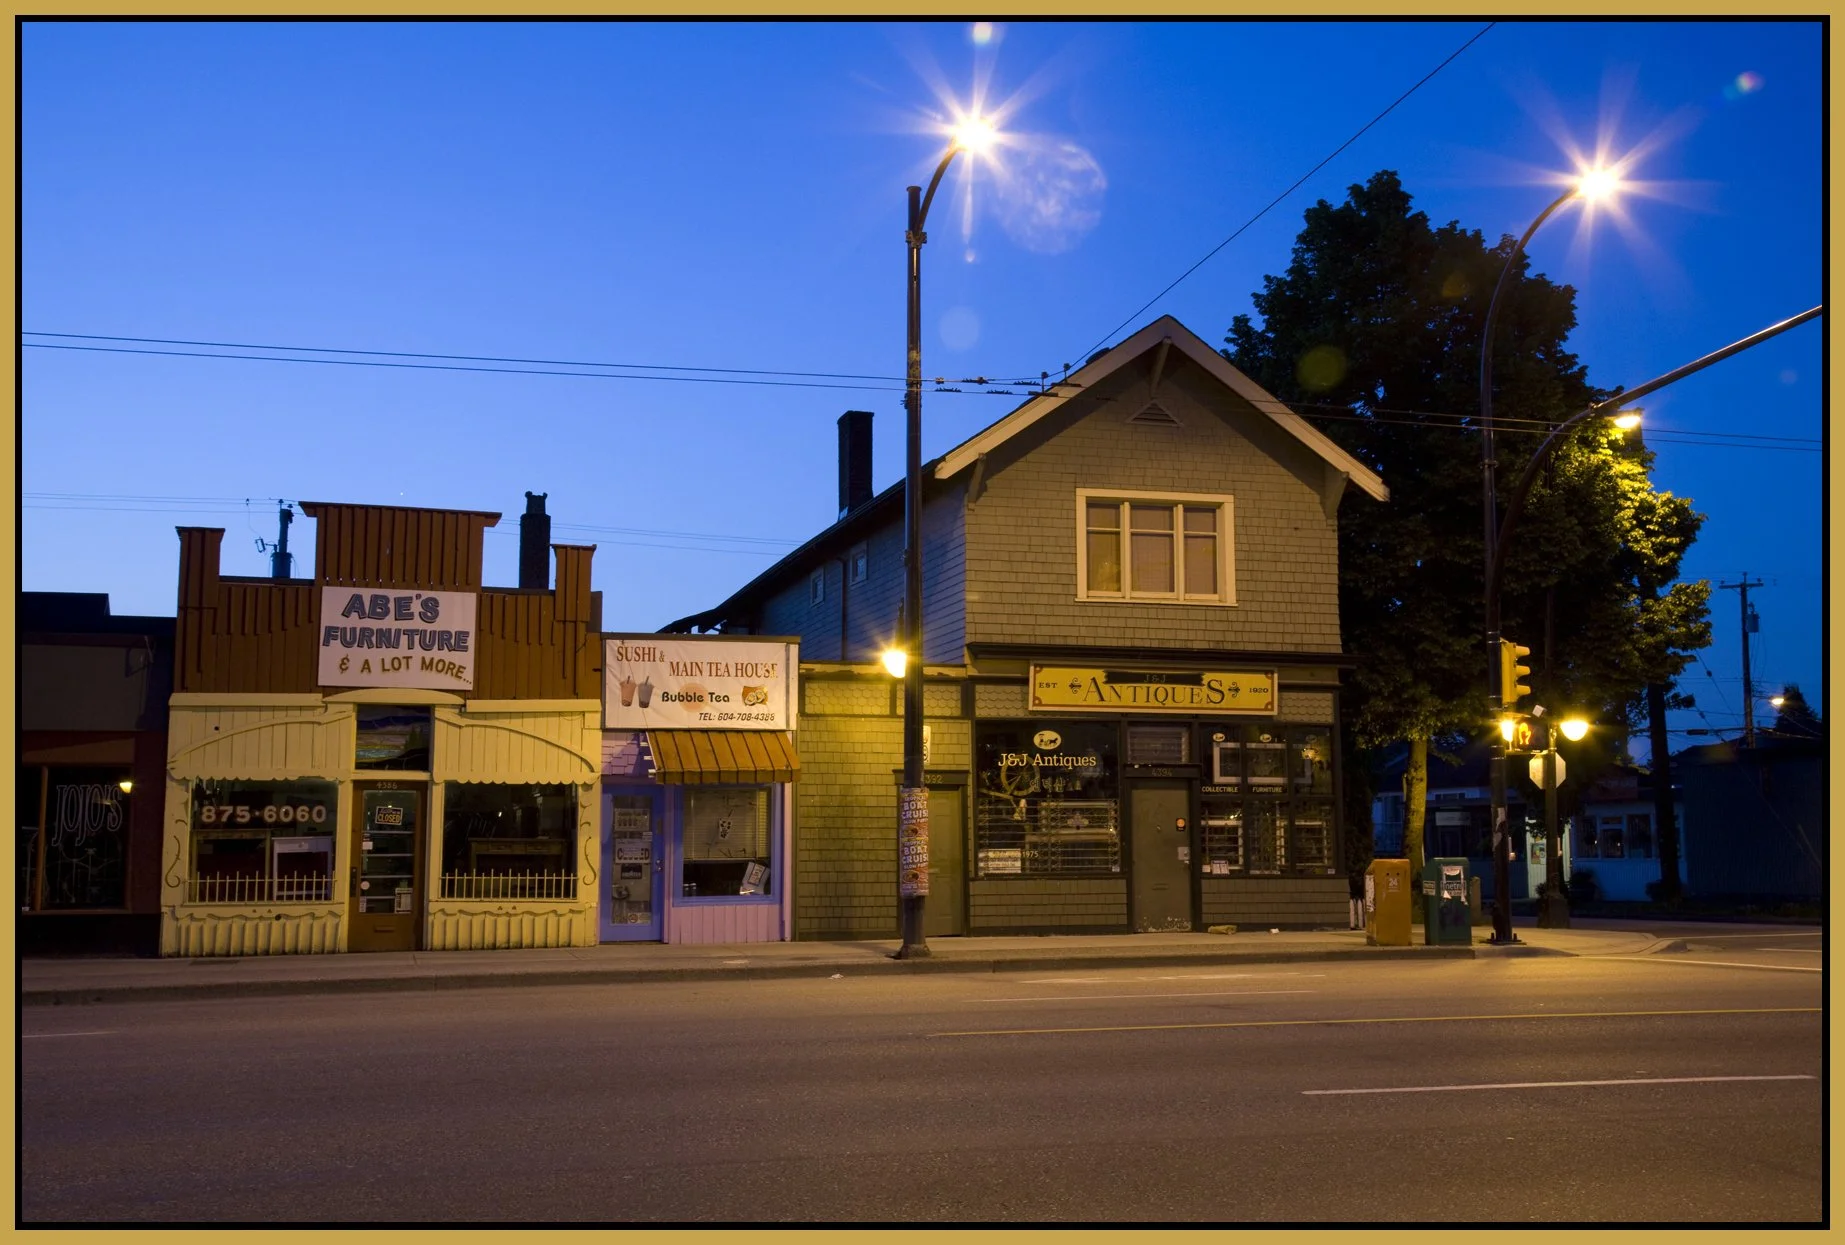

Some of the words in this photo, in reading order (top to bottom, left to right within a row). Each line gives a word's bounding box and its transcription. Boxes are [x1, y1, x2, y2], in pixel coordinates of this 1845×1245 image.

[341, 593, 440, 623] ABE'S
[322, 625, 470, 652] FURNITURE
[616, 646, 656, 663] SUSHI
[658, 650, 665, 663] &
[360, 659, 372, 673] A
[381, 656, 413, 672] LOT
[669, 661, 704, 677] MAIN
[707, 662, 731, 678] TEA
[734, 662, 778, 679] HOUSE
[661, 691, 704, 703] Bubble
[708, 691, 730, 703] Tea
[1083, 677, 1225, 706] ANTIQUES
[698, 713, 716, 721] TEL:
[998, 753, 1028, 767] J&J
[1032, 752, 1097, 770] Antiques
[902, 809, 928, 820] CRUIS
[903, 801, 927, 811] BOAT
[51, 784, 123, 847] JOJO'S
[377, 813, 401, 823] CLOSED
[902, 853, 928, 864] CRUIS
[903, 845, 928, 855] BOAT
